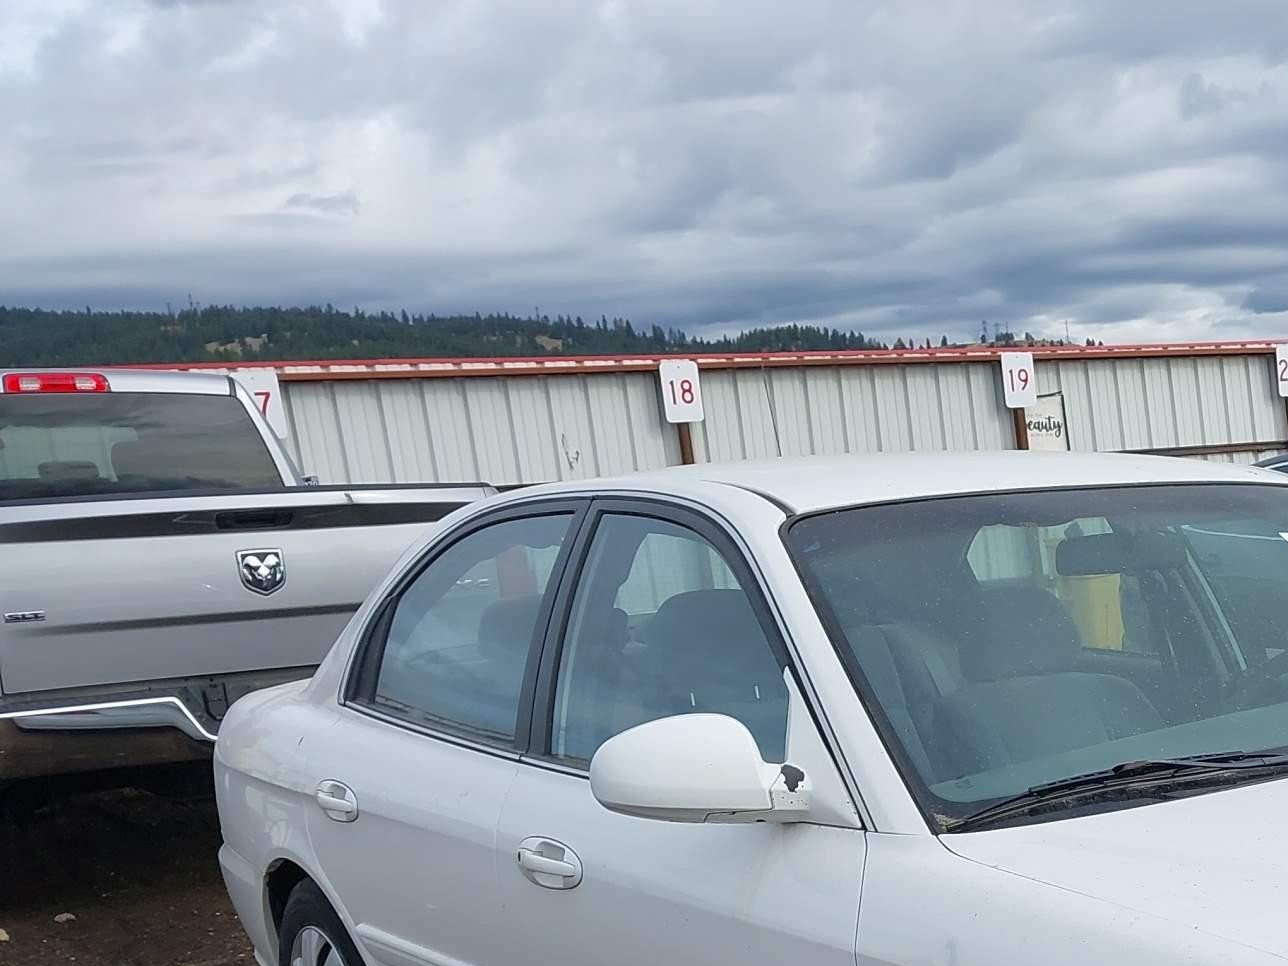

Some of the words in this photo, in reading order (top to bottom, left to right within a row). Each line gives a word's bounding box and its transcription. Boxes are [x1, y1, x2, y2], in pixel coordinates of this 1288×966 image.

[669, 379, 695, 405] 18
[1008, 368, 1029, 392] 19
[254, 391, 271, 418] 7
[1027, 415, 1064, 438] eauty
